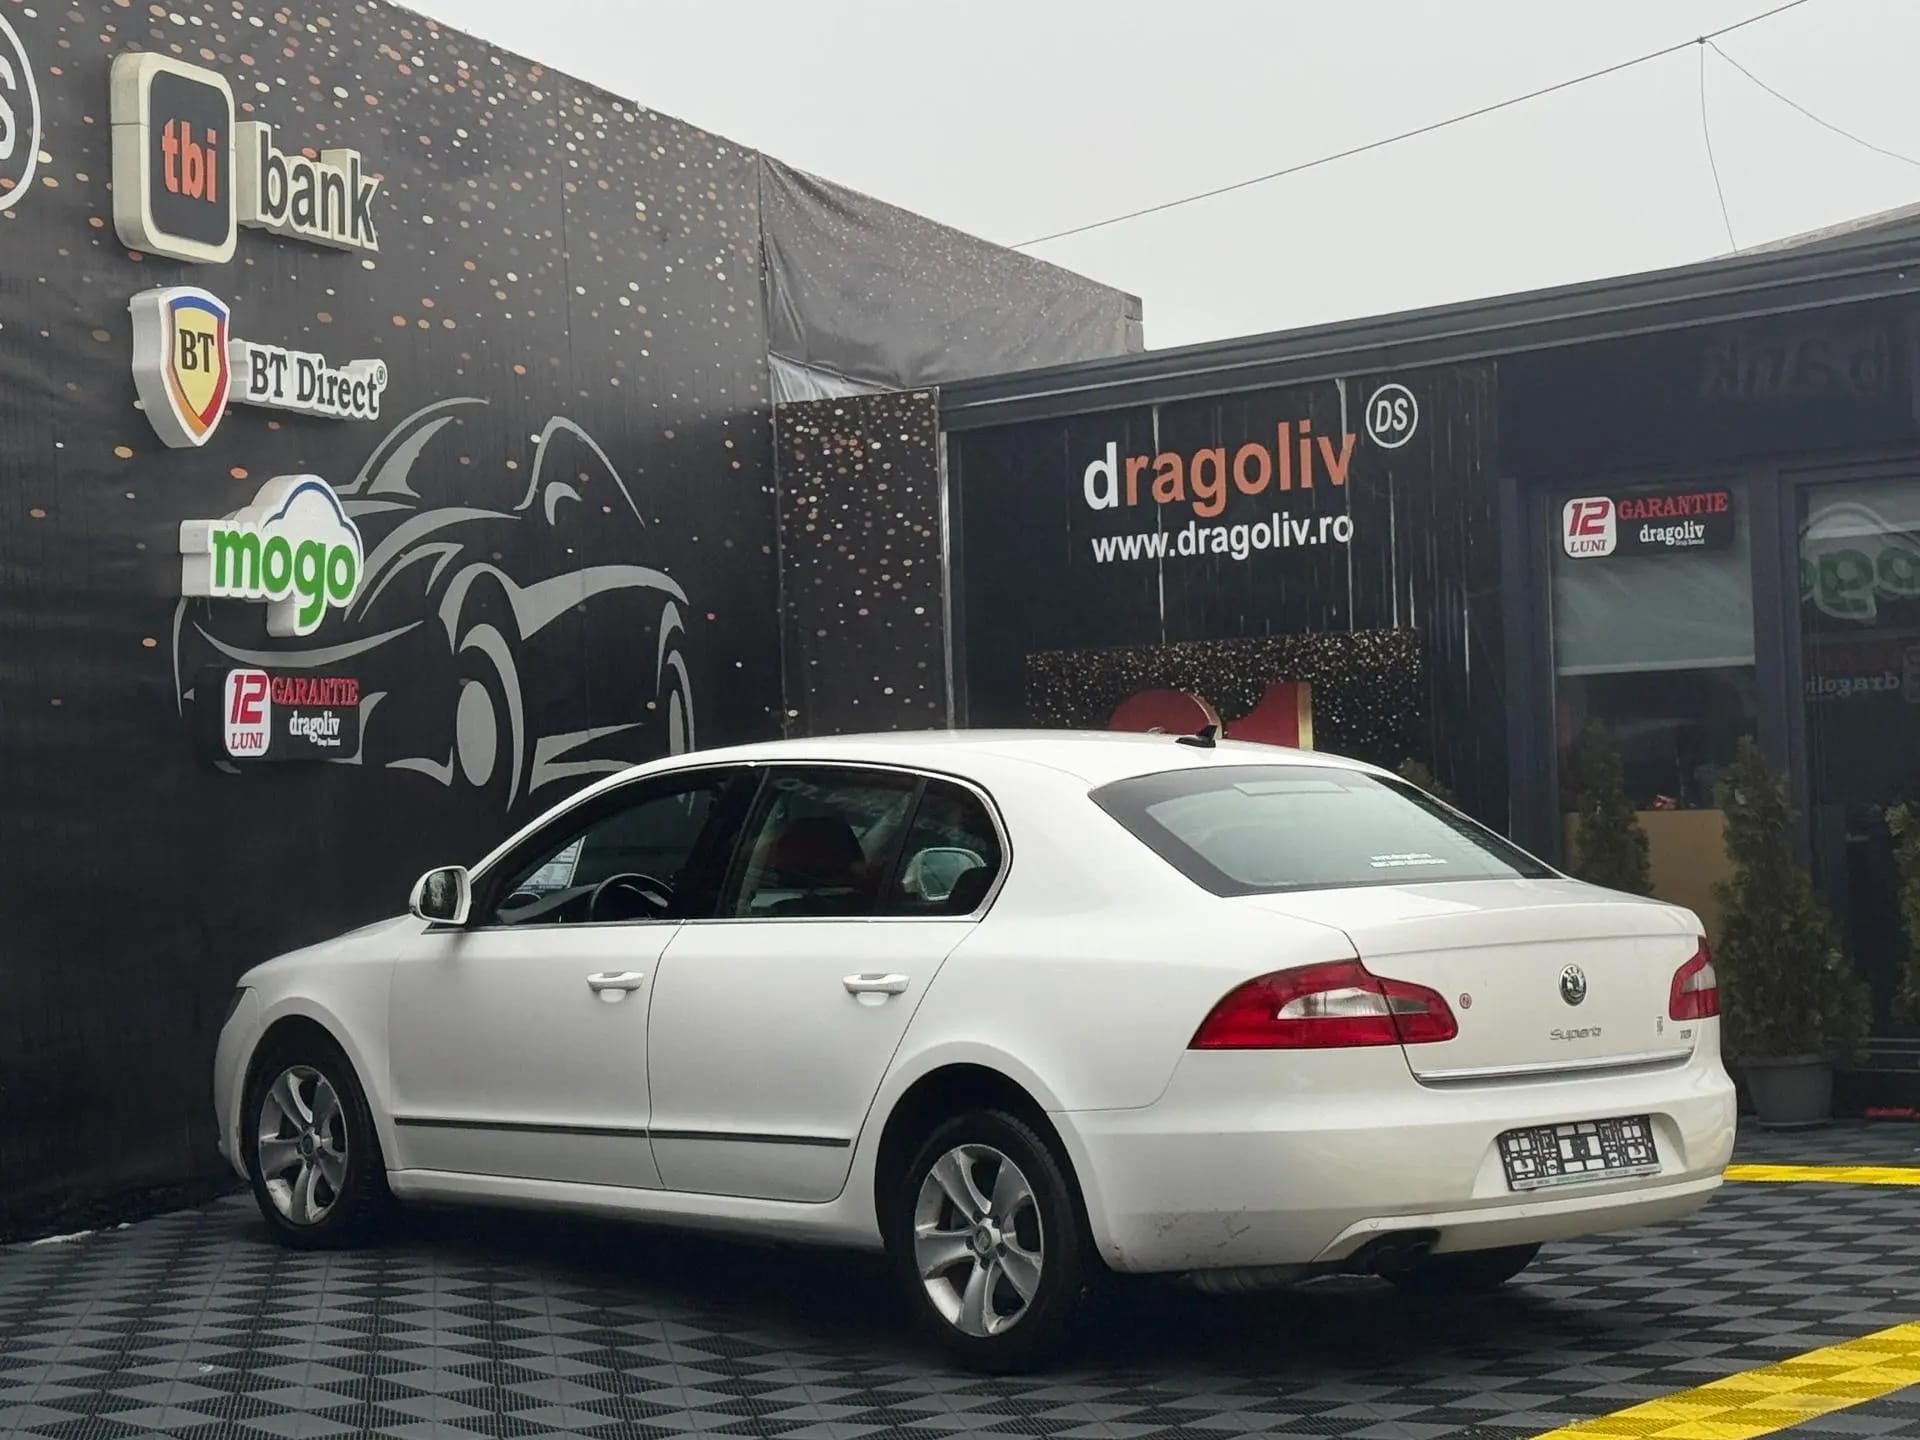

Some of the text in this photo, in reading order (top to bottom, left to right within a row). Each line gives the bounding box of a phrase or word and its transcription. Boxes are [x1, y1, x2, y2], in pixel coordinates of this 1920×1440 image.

[161, 117, 378, 248] tbi bank
[178, 328, 215, 373] BT
[250, 349, 288, 398] BT
[1374, 398, 1408, 433] DS
[1083, 420, 1356, 517] dragoliv
[1569, 500, 1610, 537] 12
[1618, 491, 1728, 520] GARANTIE
[1091, 512, 1354, 563] www.dragoliv.ro
[1570, 539, 1607, 553] LUNI
[1639, 520, 1704, 545] dragoliv
[212, 529, 356, 628] mogo
[230, 674, 267, 724] 12
[271, 676, 359, 706] GARANTIE
[231, 732, 264, 750] LUNI
[289, 710, 340, 743] dragoliv
